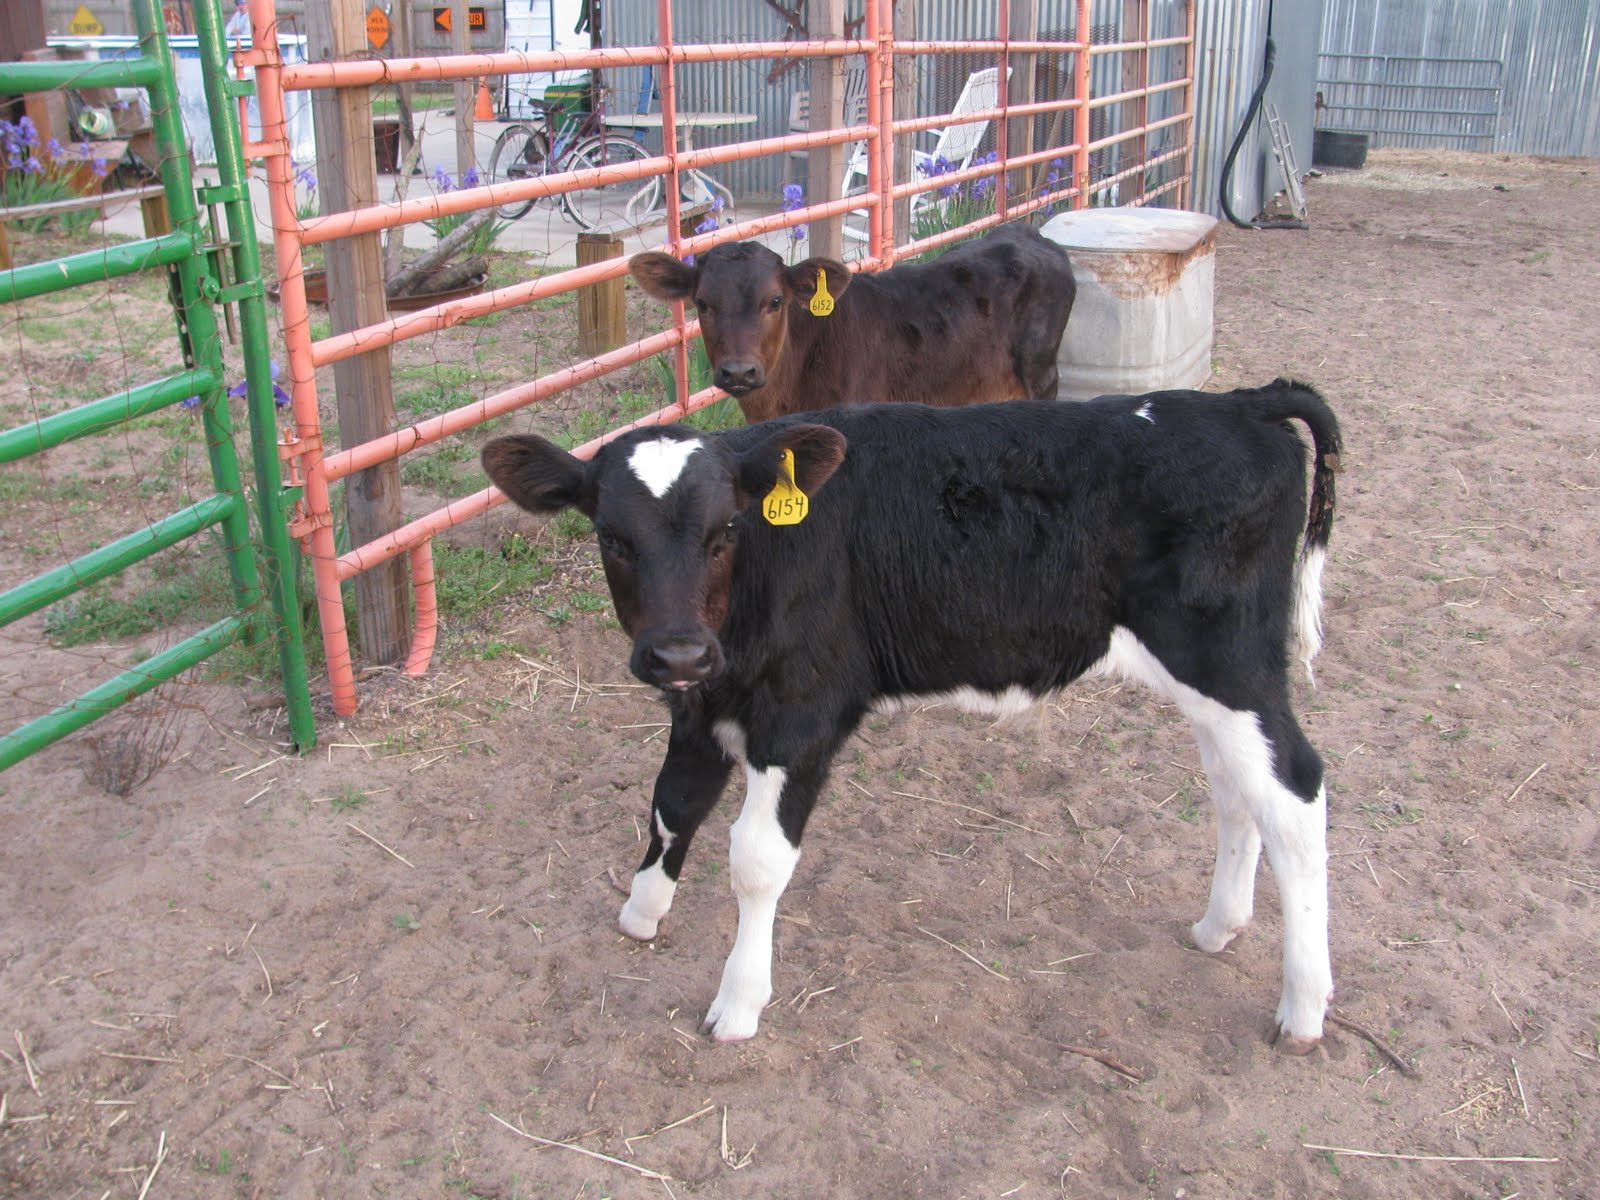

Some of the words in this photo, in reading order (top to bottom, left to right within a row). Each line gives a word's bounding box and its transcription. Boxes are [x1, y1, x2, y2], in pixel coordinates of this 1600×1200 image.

[73, 23, 98, 33] BUMP
[812, 299, 832, 311] 6152
[767, 496, 804, 519] 6154
